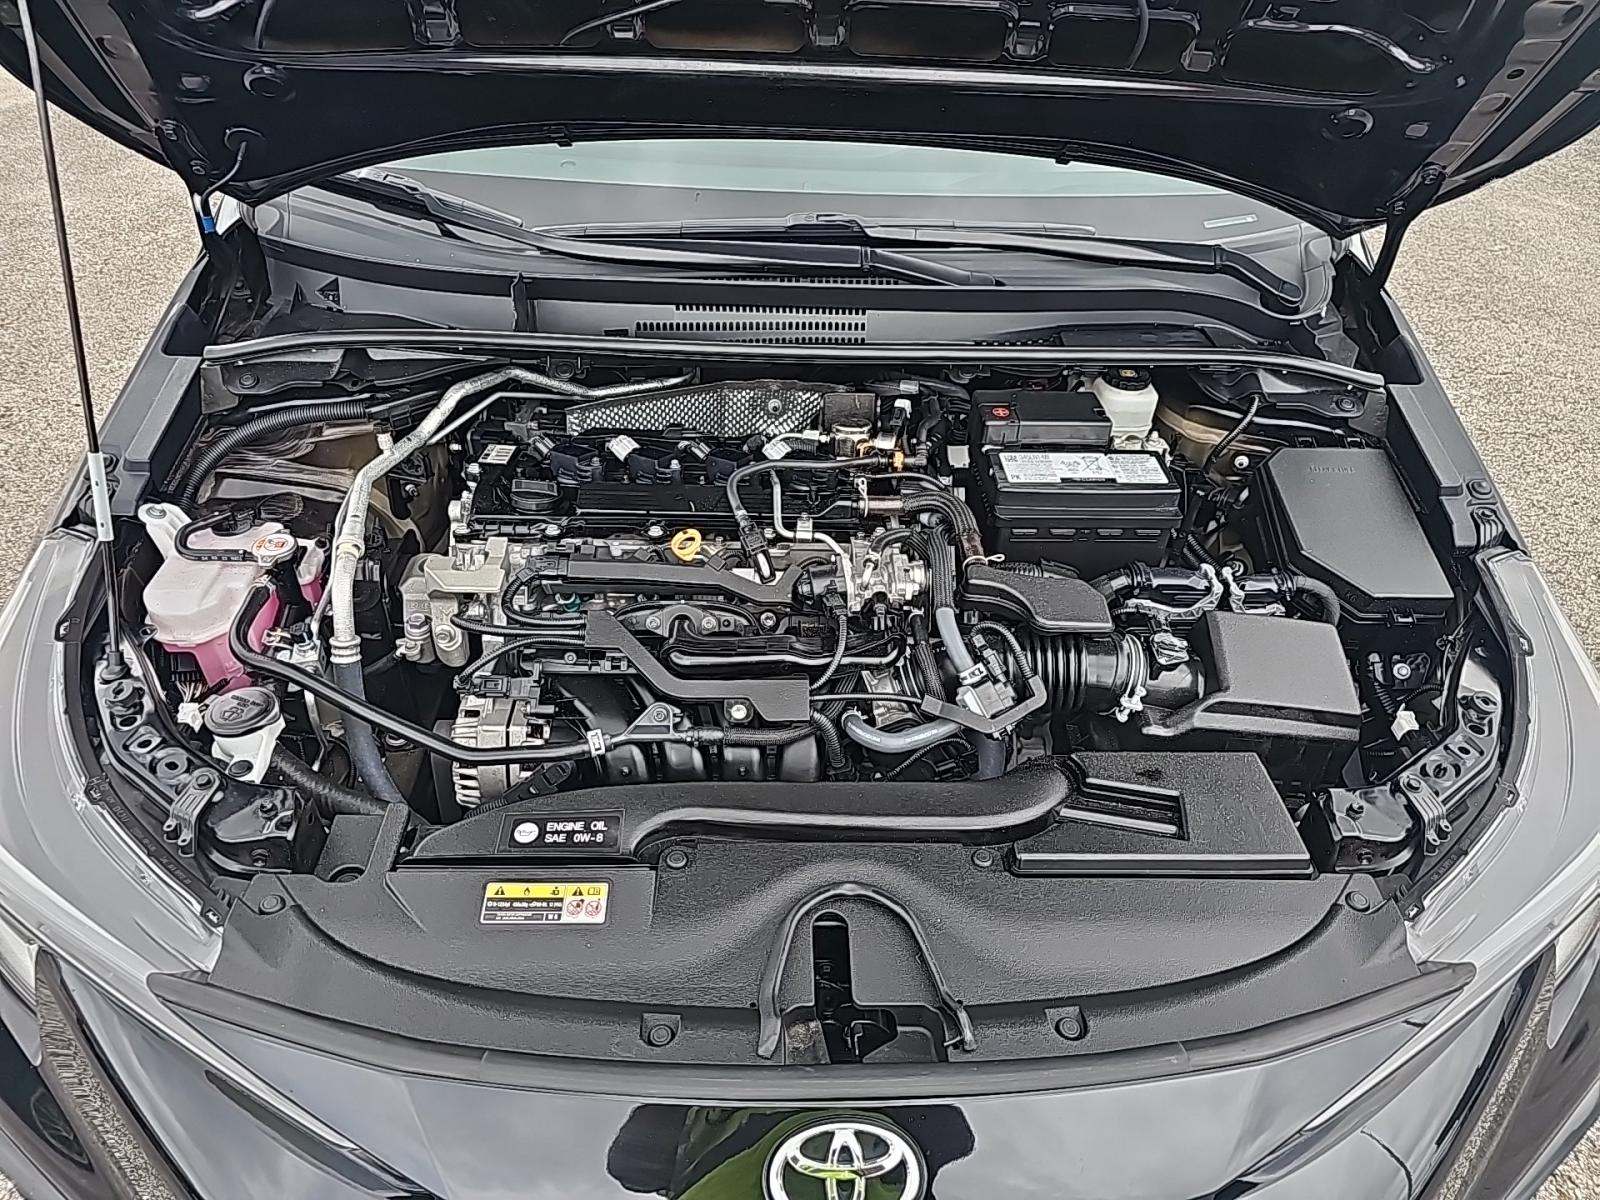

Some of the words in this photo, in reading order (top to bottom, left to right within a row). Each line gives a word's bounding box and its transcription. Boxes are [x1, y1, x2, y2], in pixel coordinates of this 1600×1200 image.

[546, 821, 585, 832] ENGINE
[590, 820, 608, 831] OIL
[544, 833, 567, 843] SAE
[573, 832, 604, 843] 0W-8
